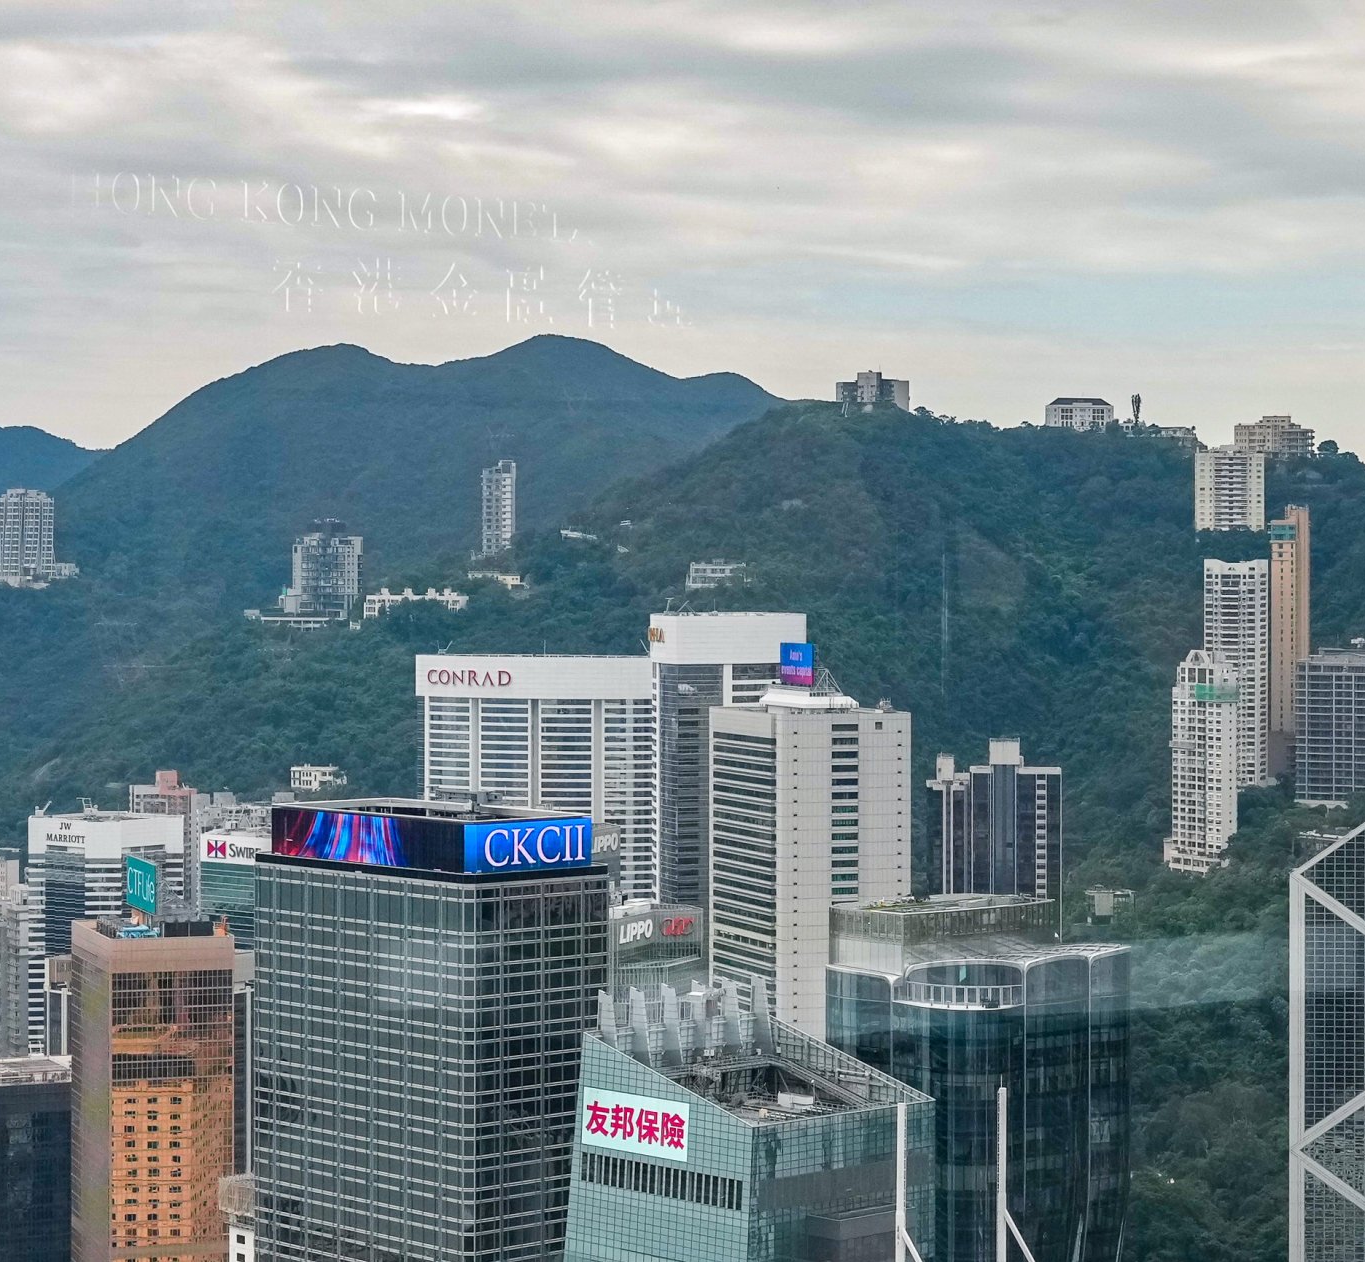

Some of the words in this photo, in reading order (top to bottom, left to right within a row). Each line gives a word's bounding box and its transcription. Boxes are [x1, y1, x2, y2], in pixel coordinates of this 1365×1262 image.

[239, 178, 378, 231] KONG
[427, 669, 512, 687] CONRAD
[59, 822, 72, 830] JW
[46, 832, 85, 844] MARRIOTT
[618, 918, 653, 945] LIPPO
[585, 1101, 685, 1149] 友邦保險
